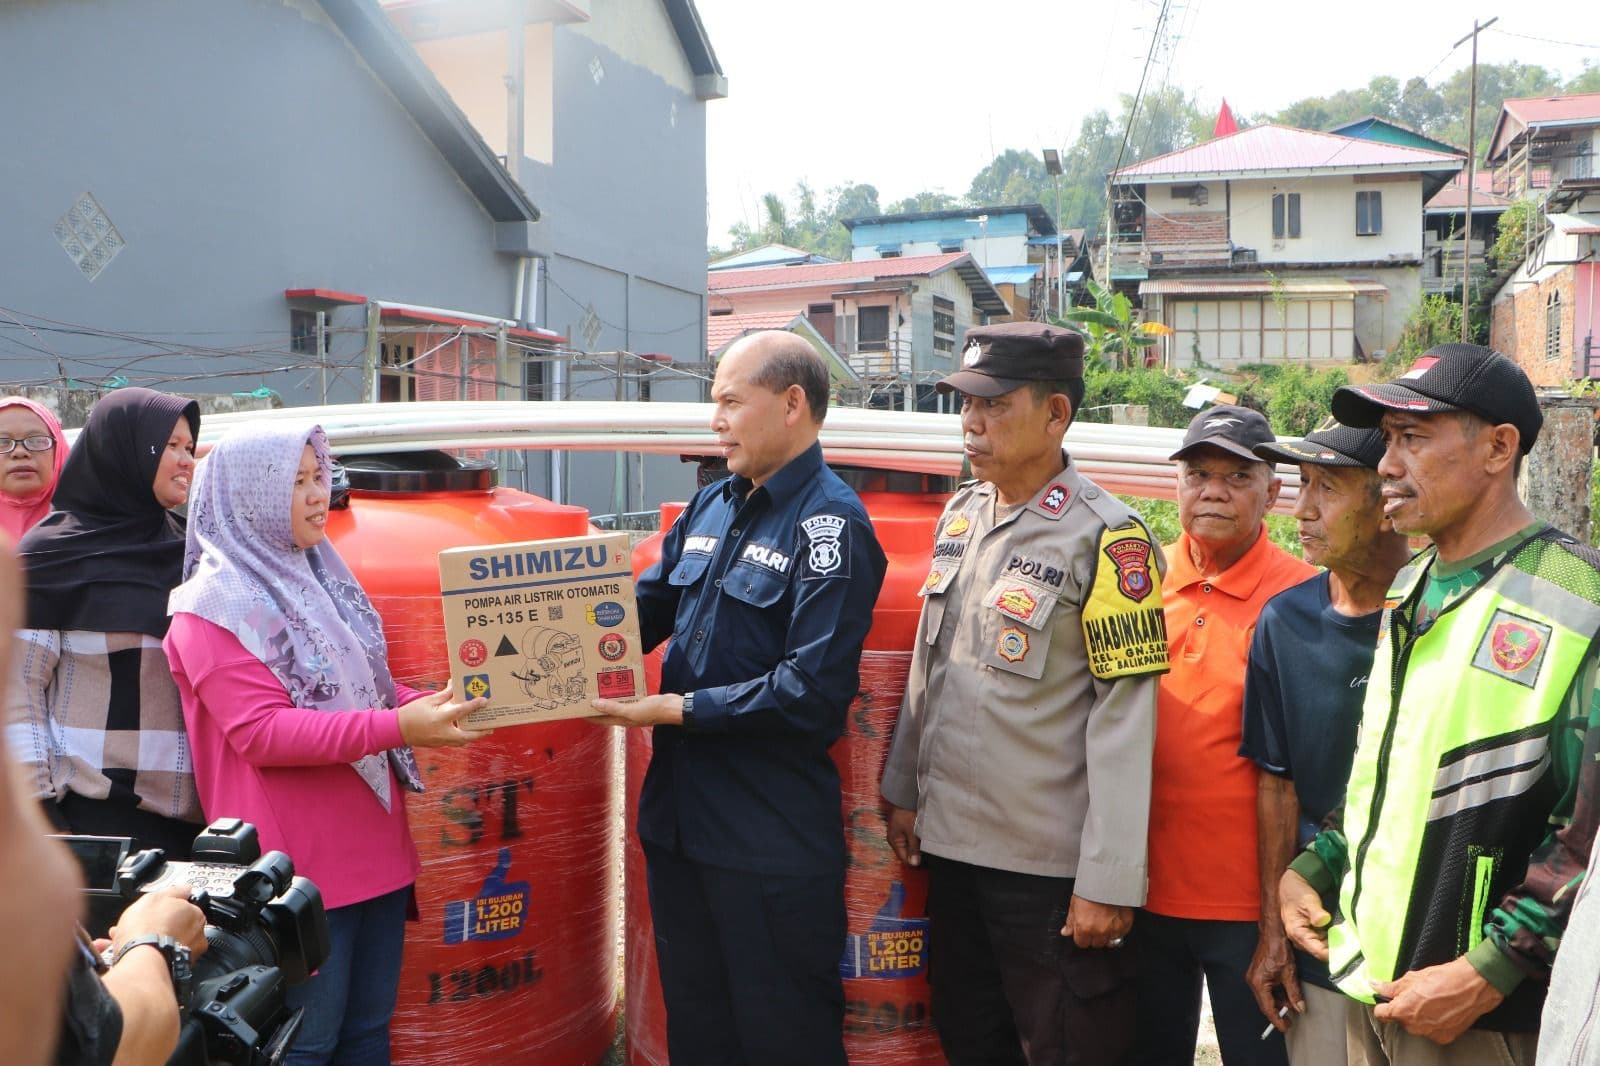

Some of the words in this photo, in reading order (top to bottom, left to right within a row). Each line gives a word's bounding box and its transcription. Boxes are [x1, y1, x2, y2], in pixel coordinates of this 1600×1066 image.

[805, 518, 842, 531] POLDA
[469, 544, 607, 581] SHIMIZU
[743, 545, 789, 572] POLRI
[1008, 556, 1064, 588] POLRI
[465, 598, 501, 609] POMPA
[504, 594, 521, 605] AIR
[525, 589, 563, 603] LISTRIK
[567, 583, 620, 599] OTOMATIS
[467, 611, 523, 628] PS-135
[529, 609, 539, 621] E
[1093, 652, 1118, 664] KEL.
[1096, 663, 1112, 673] KEC.
[1118, 654, 1165, 669] BALIKPAPAN
[477, 900, 523, 919] 1.200
[475, 916, 520, 934] LITER
[869, 938, 924, 956] 1.200
[869, 954, 921, 971] LITER
[427, 951, 544, 1004] 1200L
